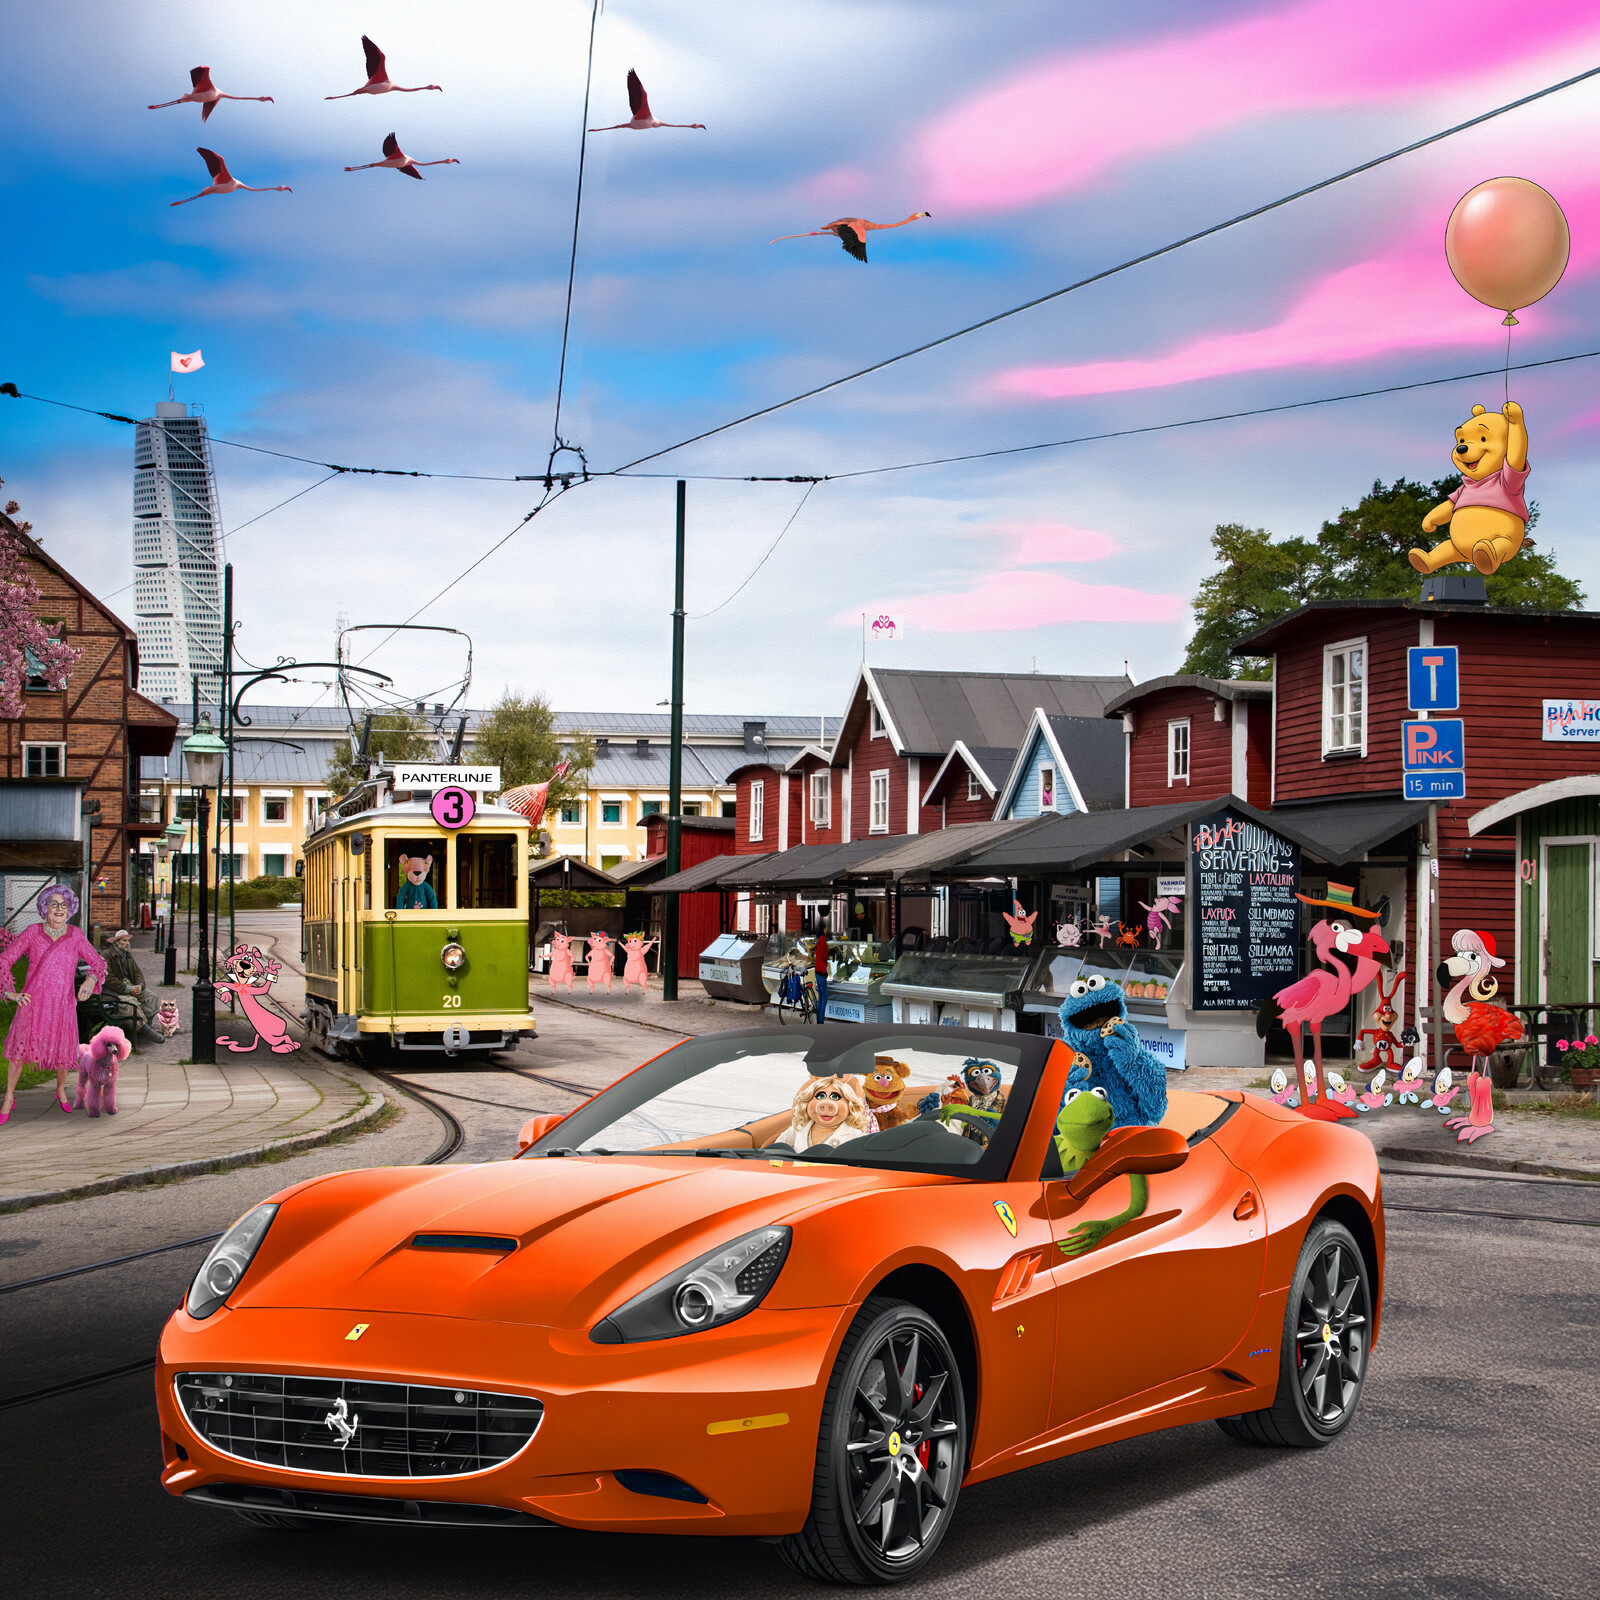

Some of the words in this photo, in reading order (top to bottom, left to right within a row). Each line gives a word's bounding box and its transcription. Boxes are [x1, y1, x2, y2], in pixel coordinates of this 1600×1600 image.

[1407, 725, 1455, 764] PINK
[402, 773, 493, 783] PANTERLINJE
[1410, 780, 1423, 791] 15
[1430, 779, 1454, 791] min
[443, 791, 464, 824] 3
[1200, 850, 1280, 873] SERVERING
[1520, 859, 1536, 880] 01
[1200, 872, 1216, 884] FISH
[1223, 872, 1244, 884] CHIPS
[1249, 873, 1295, 886] LAXTALLRIK
[1201, 907, 1236, 920] LAXPUCK
[1248, 907, 1262, 920] SILL
[1263, 908, 1277, 920] MED
[1278, 908, 1295, 921] MOS
[1203, 944, 1218, 956] FISH
[1220, 944, 1238, 956] TACO
[1248, 945, 1294, 958] SILLMACKA
[442, 995, 462, 1008] 20
[1202, 999, 1216, 1007] ALLA
[1139, 1036, 1174, 1057] ervering
[1378, 1040, 1387, 1049] N
